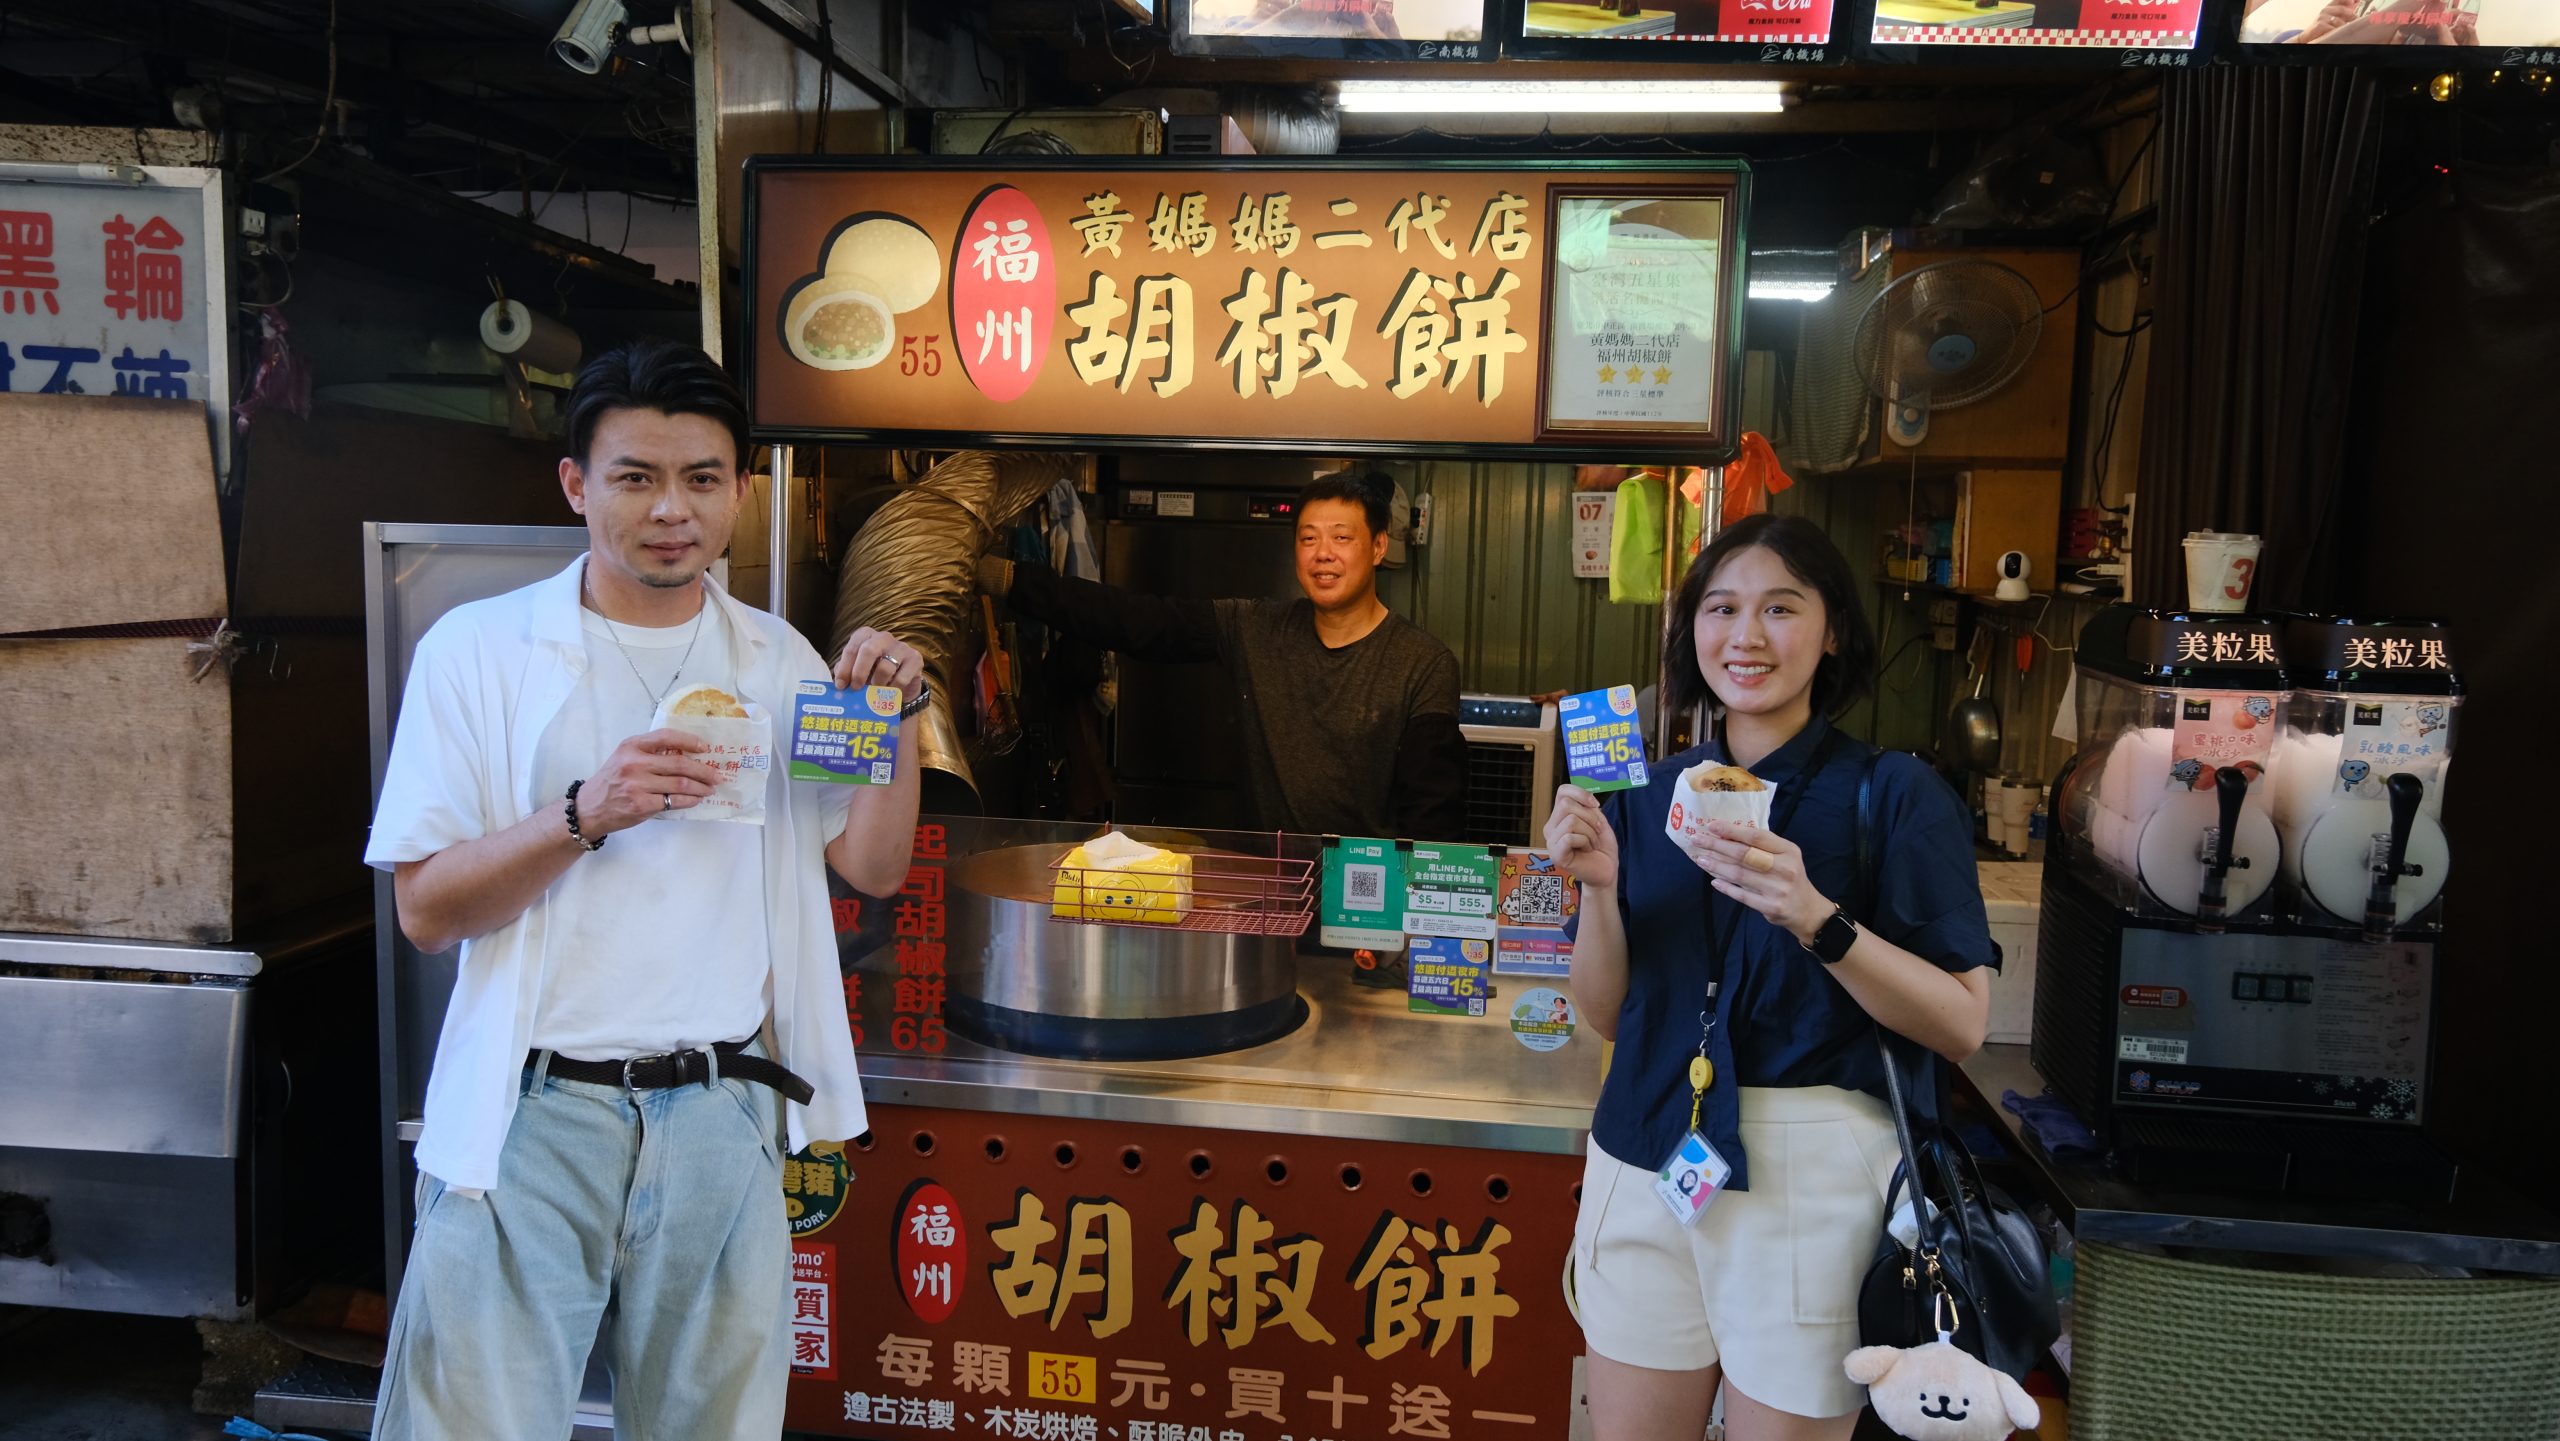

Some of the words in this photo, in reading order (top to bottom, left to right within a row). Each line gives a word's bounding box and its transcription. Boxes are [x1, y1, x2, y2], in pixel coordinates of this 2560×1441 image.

[1439, 44, 1479, 59] 南機場
[1782, 47, 1825, 62] 南機場
[1070, 191, 1533, 262] 黃媽媽二代店
[0, 209, 185, 322] 黑輪
[972, 218, 1040, 374] 福州
[1069, 270, 1528, 408] 胡椒餅
[1590, 333, 1681, 348] 黃媽媽二代店
[900, 334, 943, 377] 55
[1597, 348, 1672, 364] 福州胡椒餅
[1579, 503, 1603, 522] 07
[2224, 558, 2255, 600] 3
[2175, 630, 2275, 664] 美粒果
[2343, 637, 2447, 670] 美粒果
[880, 701, 895, 711] 35
[2193, 733, 2257, 748] 蜜桃口味
[2203, 748, 2242, 759] 冰沙
[2359, 740, 2432, 756] 乳酸風味
[739, 755, 769, 770] 起司
[1349, 847, 1366, 855] LINE
[1367, 847, 1380, 856] Pay
[1457, 865, 1475, 876] Pay
[1418, 894, 1432, 905] $5
[1459, 897, 1482, 908] 555
[893, 823, 948, 1015] 起司胡椒餅
[890, 1016, 947, 1054] 65
[795, 1209, 829, 1231] PORK
[909, 1203, 957, 1306] 福州
[988, 1190, 1521, 1379] 胡椒餅
[793, 1287, 825, 1321] 質
[794, 1330, 826, 1363] 家
[875, 1332, 1013, 1398] 每顆
[1040, 1358, 1083, 1398] 55
